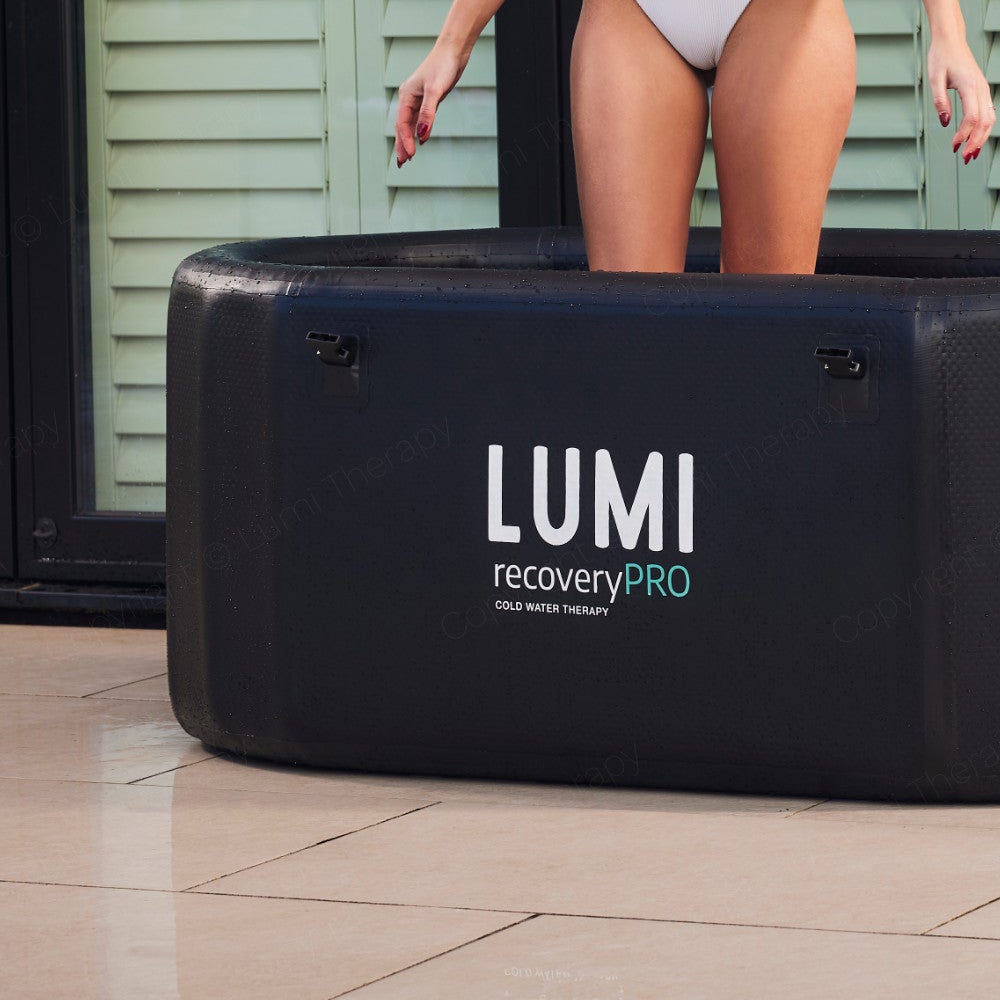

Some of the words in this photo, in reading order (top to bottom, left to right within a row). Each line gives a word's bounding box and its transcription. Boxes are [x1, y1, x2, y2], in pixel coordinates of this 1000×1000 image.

[488, 444, 694, 554] LUMI
[494, 562, 691, 604] recoveryPRO
[495, 600, 523, 611] COLD
[525, 602, 560, 613] WATER
[562, 604, 609, 616] THERAPY
